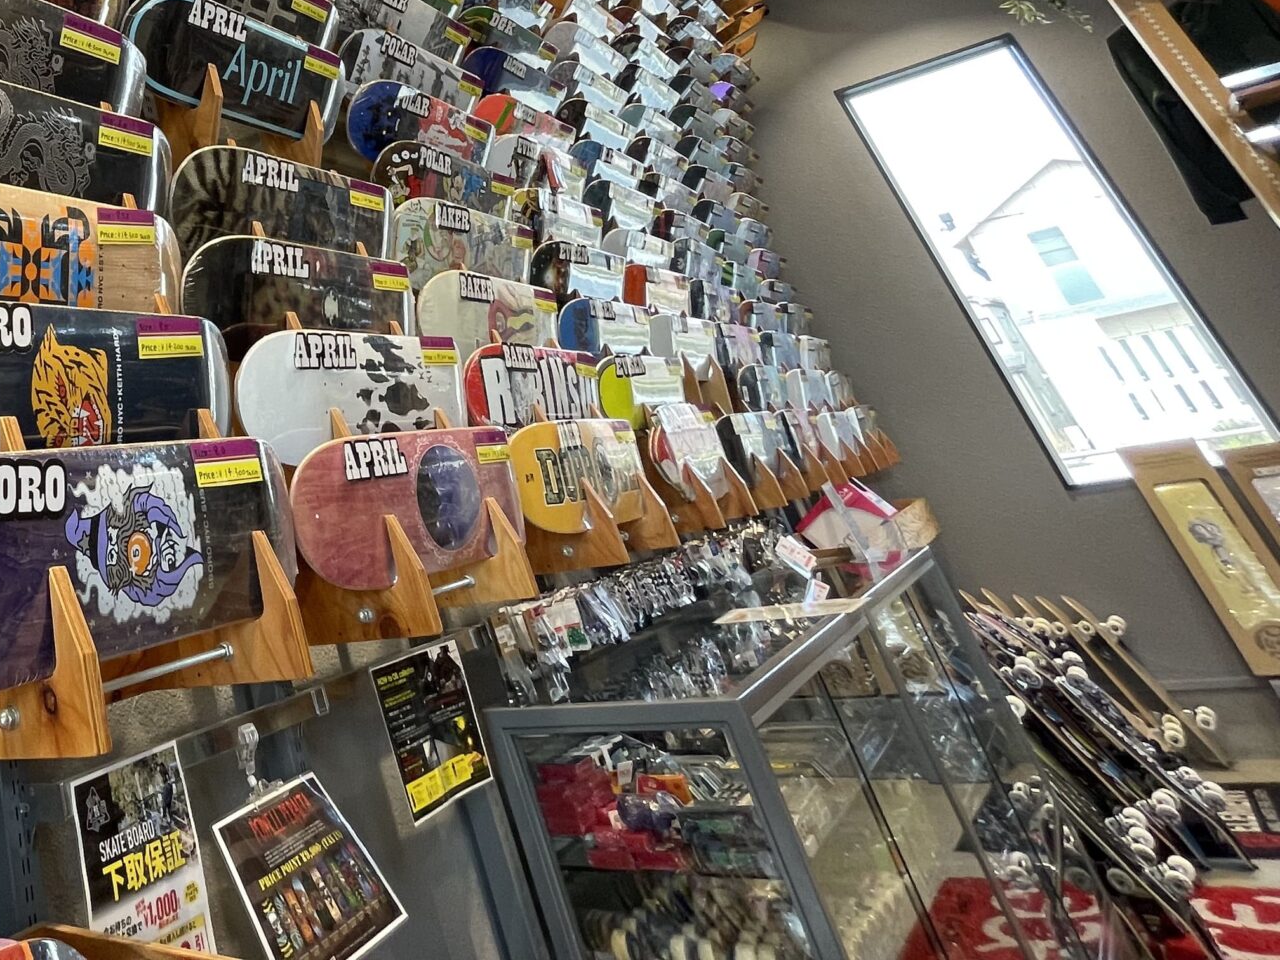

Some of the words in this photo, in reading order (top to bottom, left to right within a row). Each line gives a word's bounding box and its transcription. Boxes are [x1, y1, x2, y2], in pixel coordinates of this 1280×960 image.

[188, 0, 247, 42] APRIL
[489, 12, 516, 34] DGK
[380, 34, 417, 67] POLAR
[222, 44, 302, 105] April
[241, 153, 300, 192] APRIL
[419, 147, 452, 177] POLAR
[435, 202, 471, 232] BAKER
[251, 239, 310, 278] APRIL
[459, 275, 494, 302] BAKER
[294, 332, 357, 369] APRIL
[501, 342, 536, 370] BAKER
[343, 439, 409, 481] APRIL
[99, 832, 127, 863] SKATE
[125, 819, 156, 849] BOARD
[102, 831, 186, 902] 下取保証
[258, 867, 281, 892] PRICE
[280, 857, 302, 878] POINT
